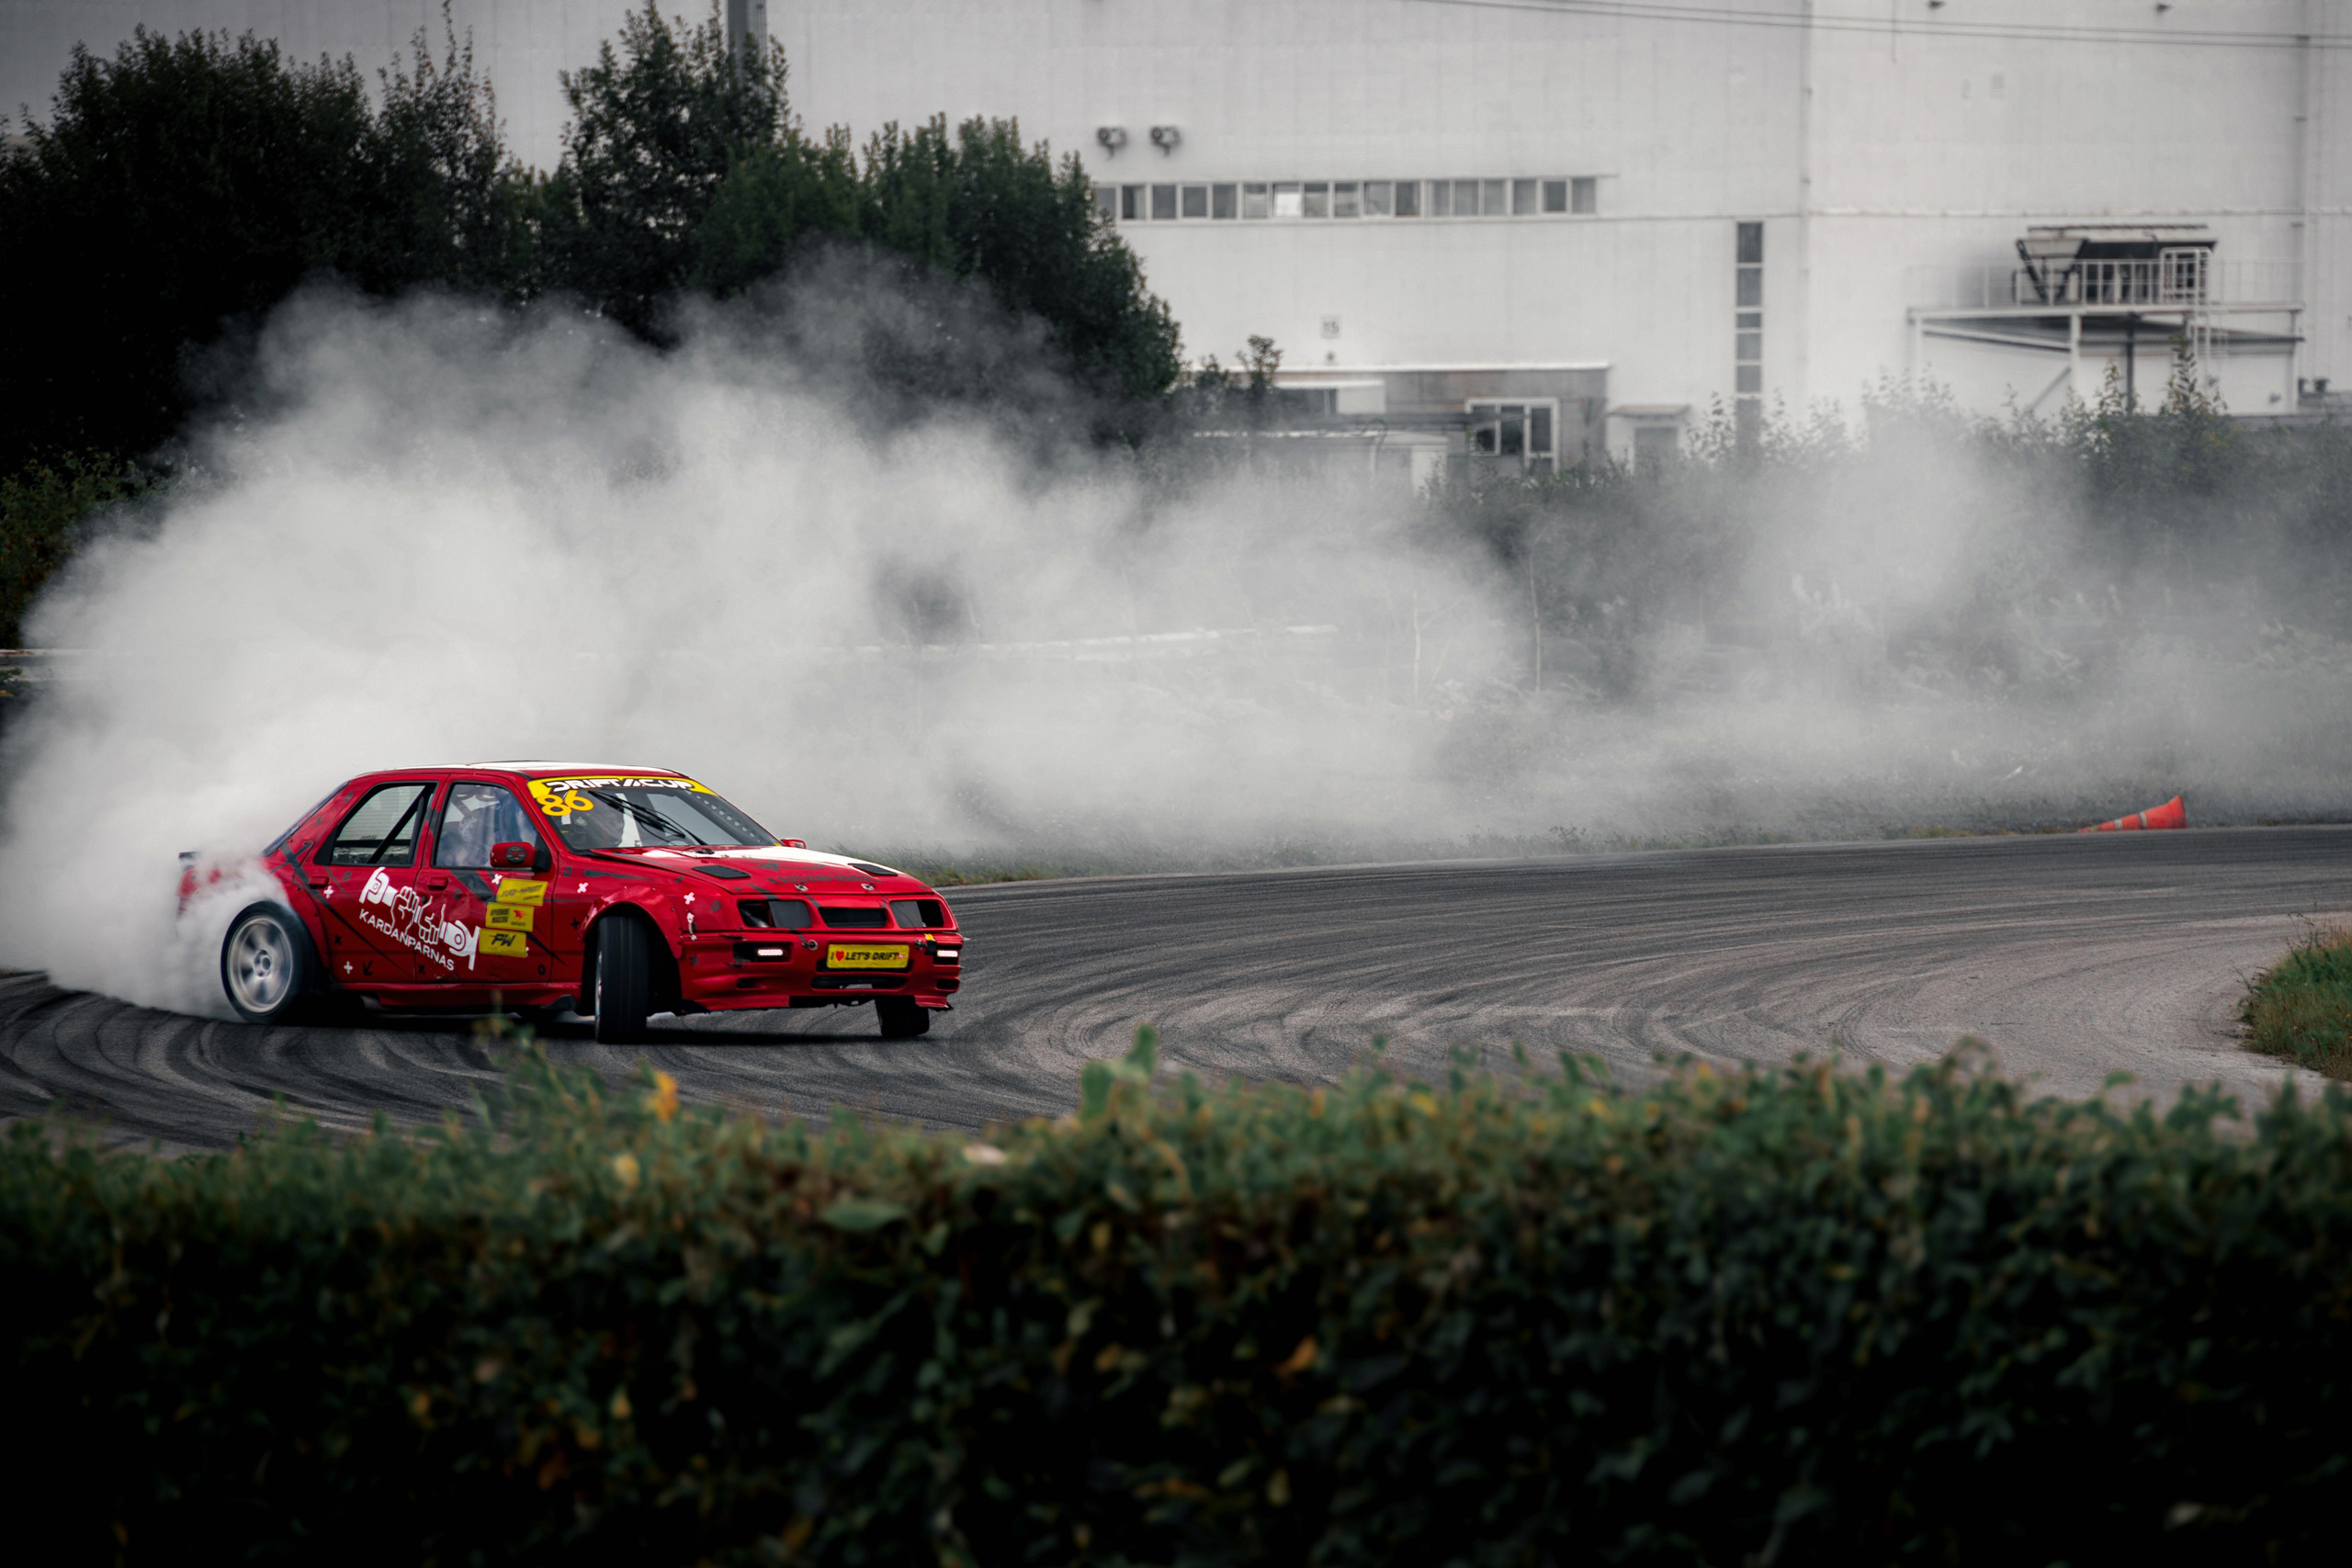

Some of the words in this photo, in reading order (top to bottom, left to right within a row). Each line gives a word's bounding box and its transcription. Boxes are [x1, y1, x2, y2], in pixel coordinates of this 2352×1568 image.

[546, 778, 621, 792] DRIFT
[639, 779, 693, 789] CUP
[537, 789, 594, 817] 86
[359, 908, 455, 971] KARDANPARNAS
[845, 952, 871, 961] LET'S
[872, 952, 899, 961] DRIFT
